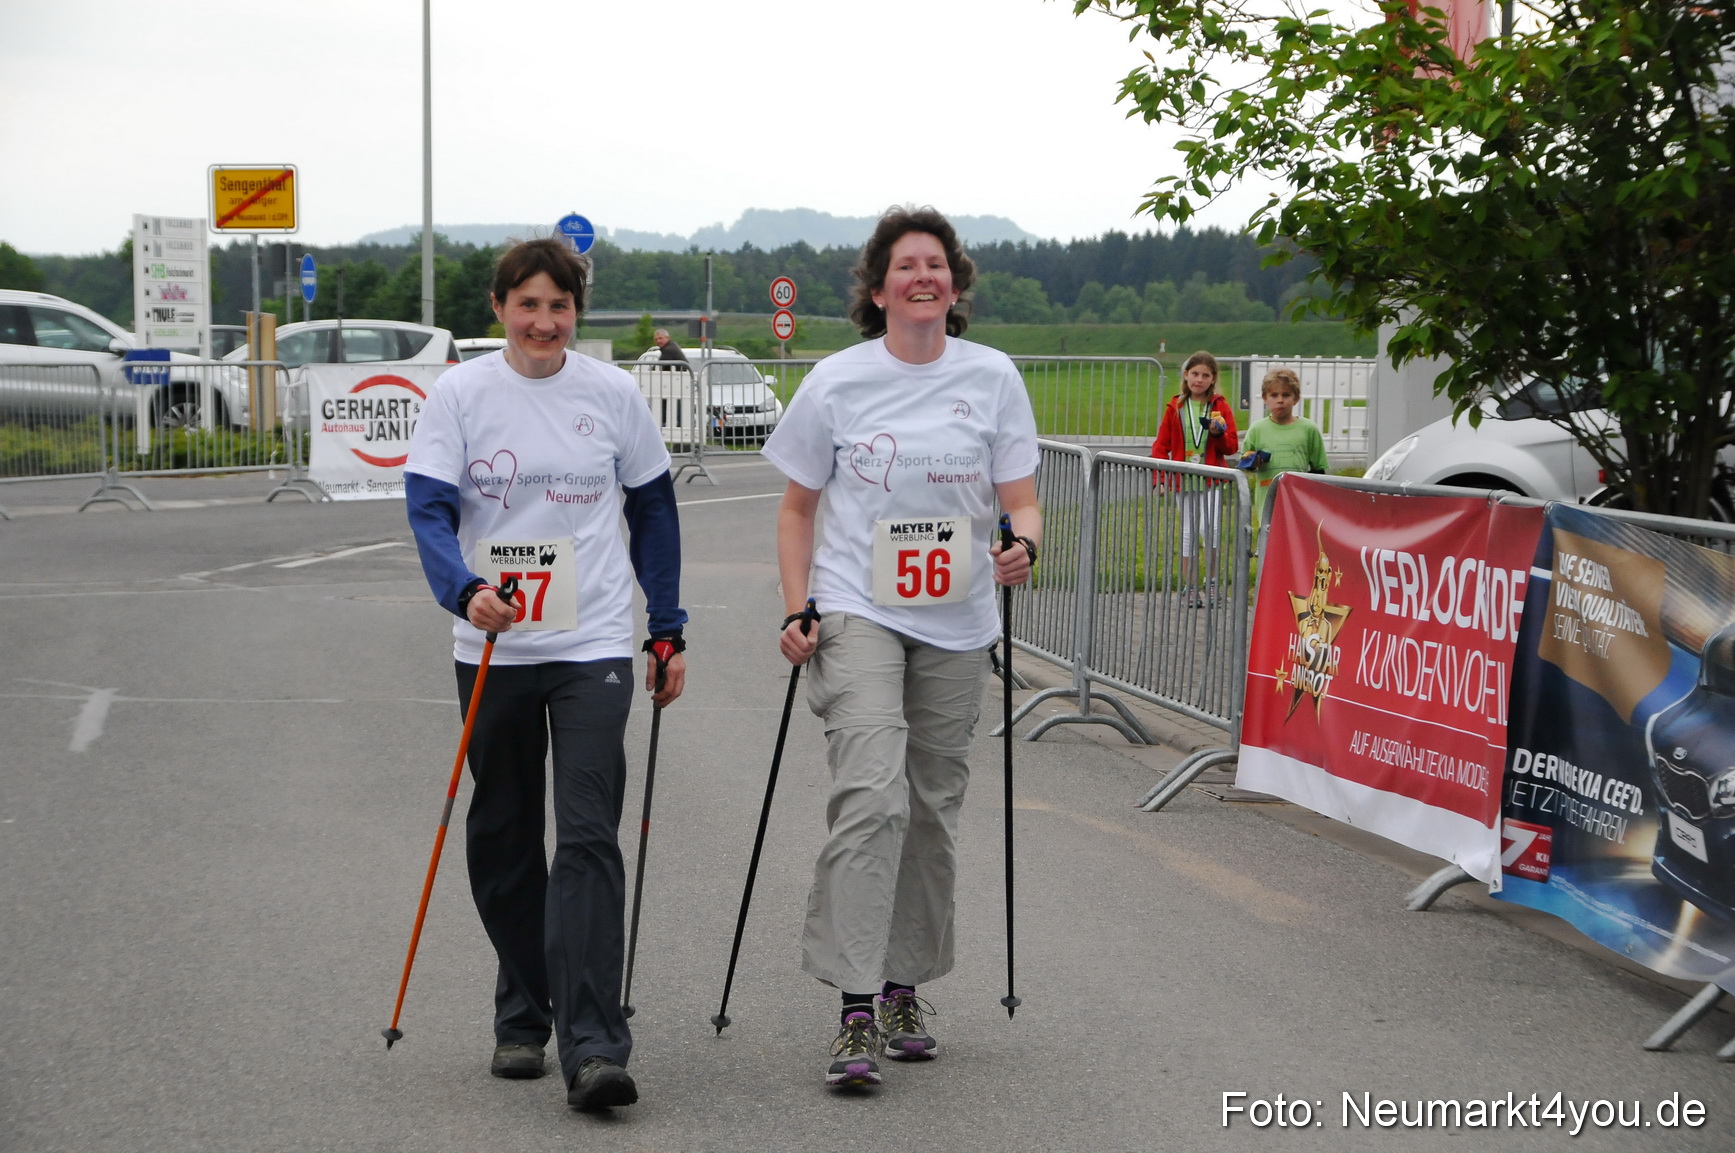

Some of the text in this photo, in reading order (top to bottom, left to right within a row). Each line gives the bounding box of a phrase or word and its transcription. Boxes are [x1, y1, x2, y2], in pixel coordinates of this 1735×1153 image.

[219, 176, 287, 195] Sengenthal
[776, 284, 790, 301] 60
[321, 398, 420, 420] GERHART &
[321, 422, 366, 434] Autohaus
[564, 472, 607, 489] Gruppe
[890, 522, 934, 535] MEYER
[890, 533, 935, 543] WERBUNG
[490, 545, 535, 557] MEYER
[490, 556, 537, 565] WERBUNG
[896, 548, 951, 598] 56
[1349, 730, 1372, 756] AUF
[1512, 747, 1559, 782] DER
[1577, 768, 1603, 801] KIA
[1501, 824, 1539, 868] 7
